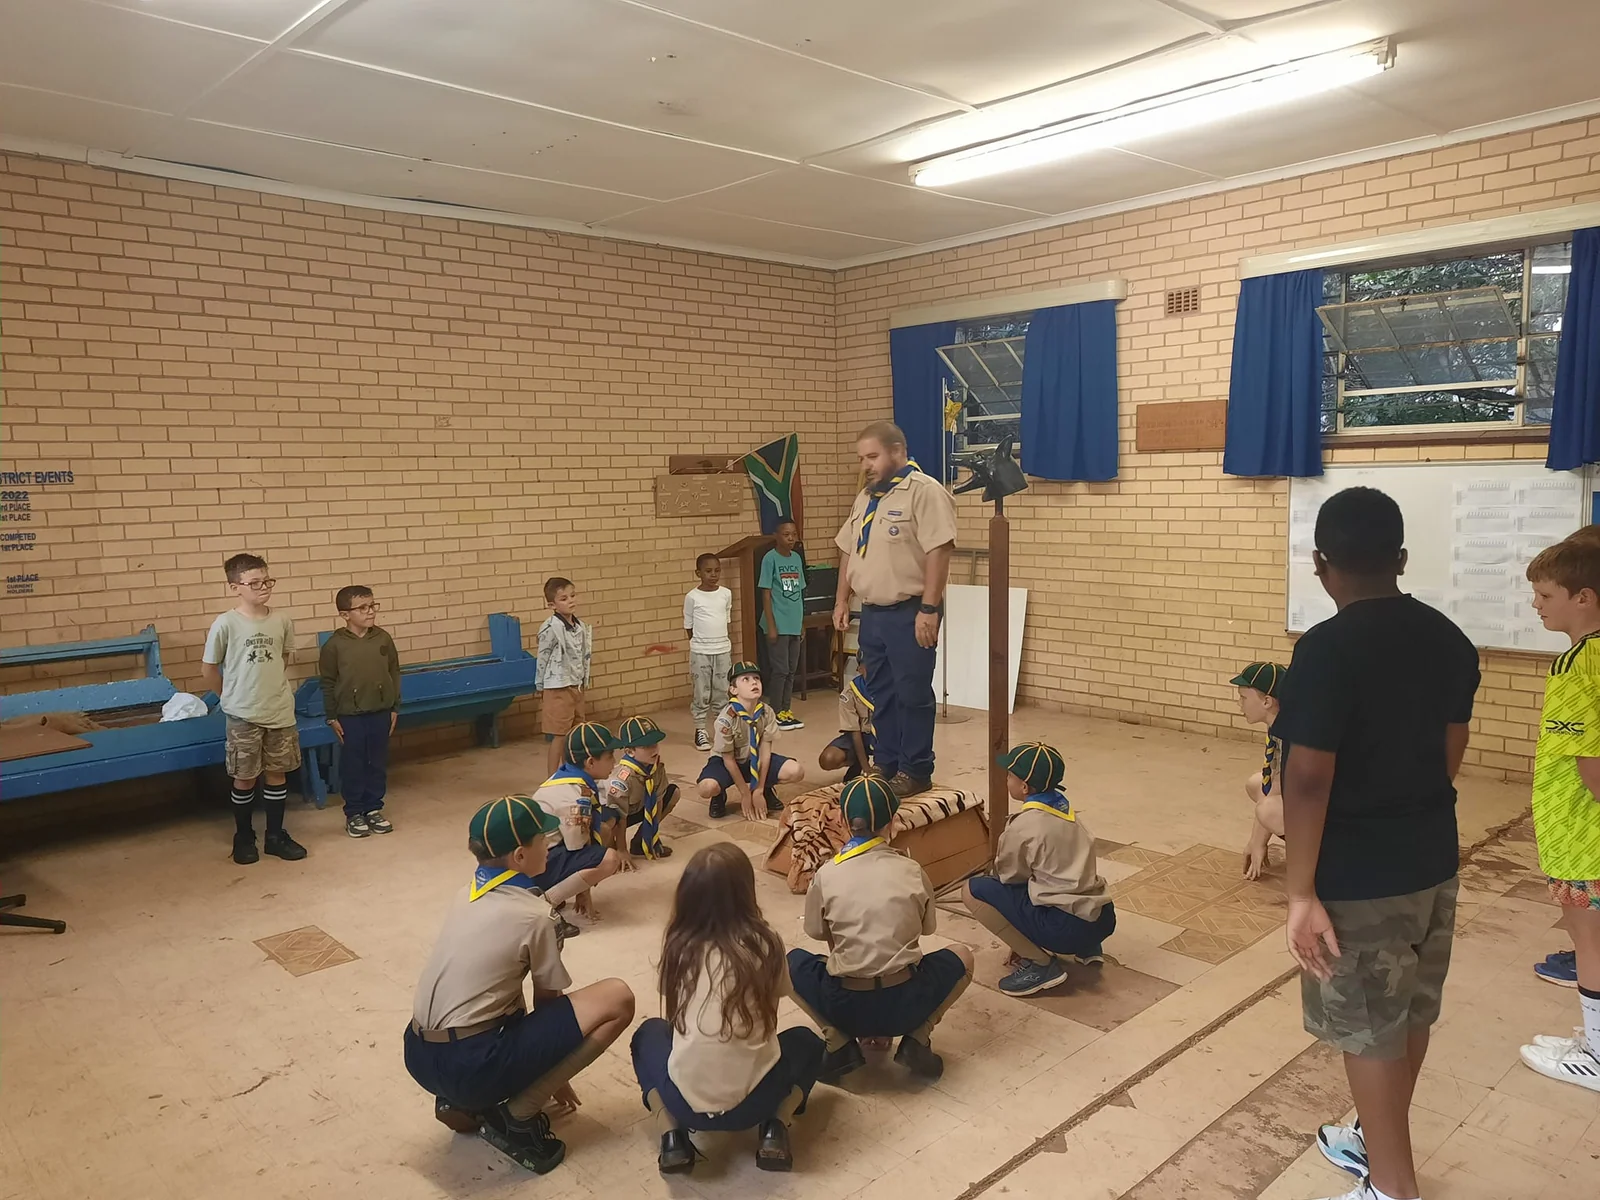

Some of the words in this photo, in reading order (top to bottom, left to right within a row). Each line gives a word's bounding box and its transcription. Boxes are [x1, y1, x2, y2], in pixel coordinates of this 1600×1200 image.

[35, 471, 74, 483] EVENTS
[1, 491, 28, 499] 2022
[9, 503, 31, 511] PLACE
[9, 513, 31, 521] PLACE
[0, 533, 36, 541] COMPETED
[11, 543, 33, 551] PLACE
[17, 573, 39, 582] PLACE
